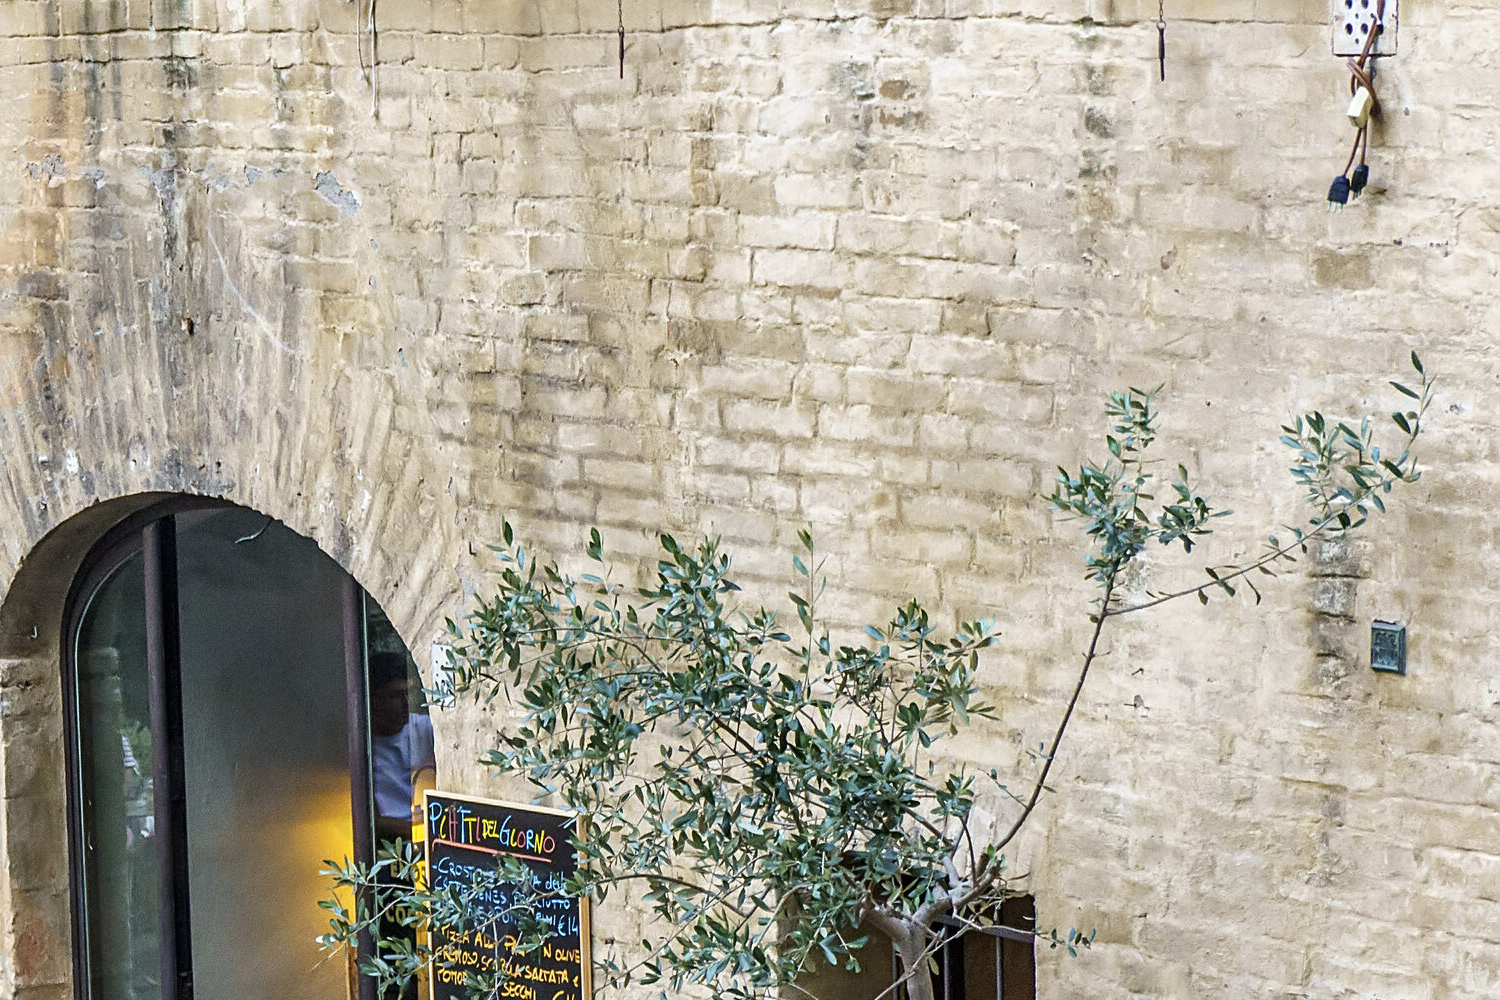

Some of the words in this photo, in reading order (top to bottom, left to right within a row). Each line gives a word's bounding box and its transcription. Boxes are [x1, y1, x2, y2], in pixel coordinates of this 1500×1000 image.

[557, 914, 578, 935] €14
[555, 948, 581, 964] OLIVE
[524, 965, 569, 984] SALTATA
